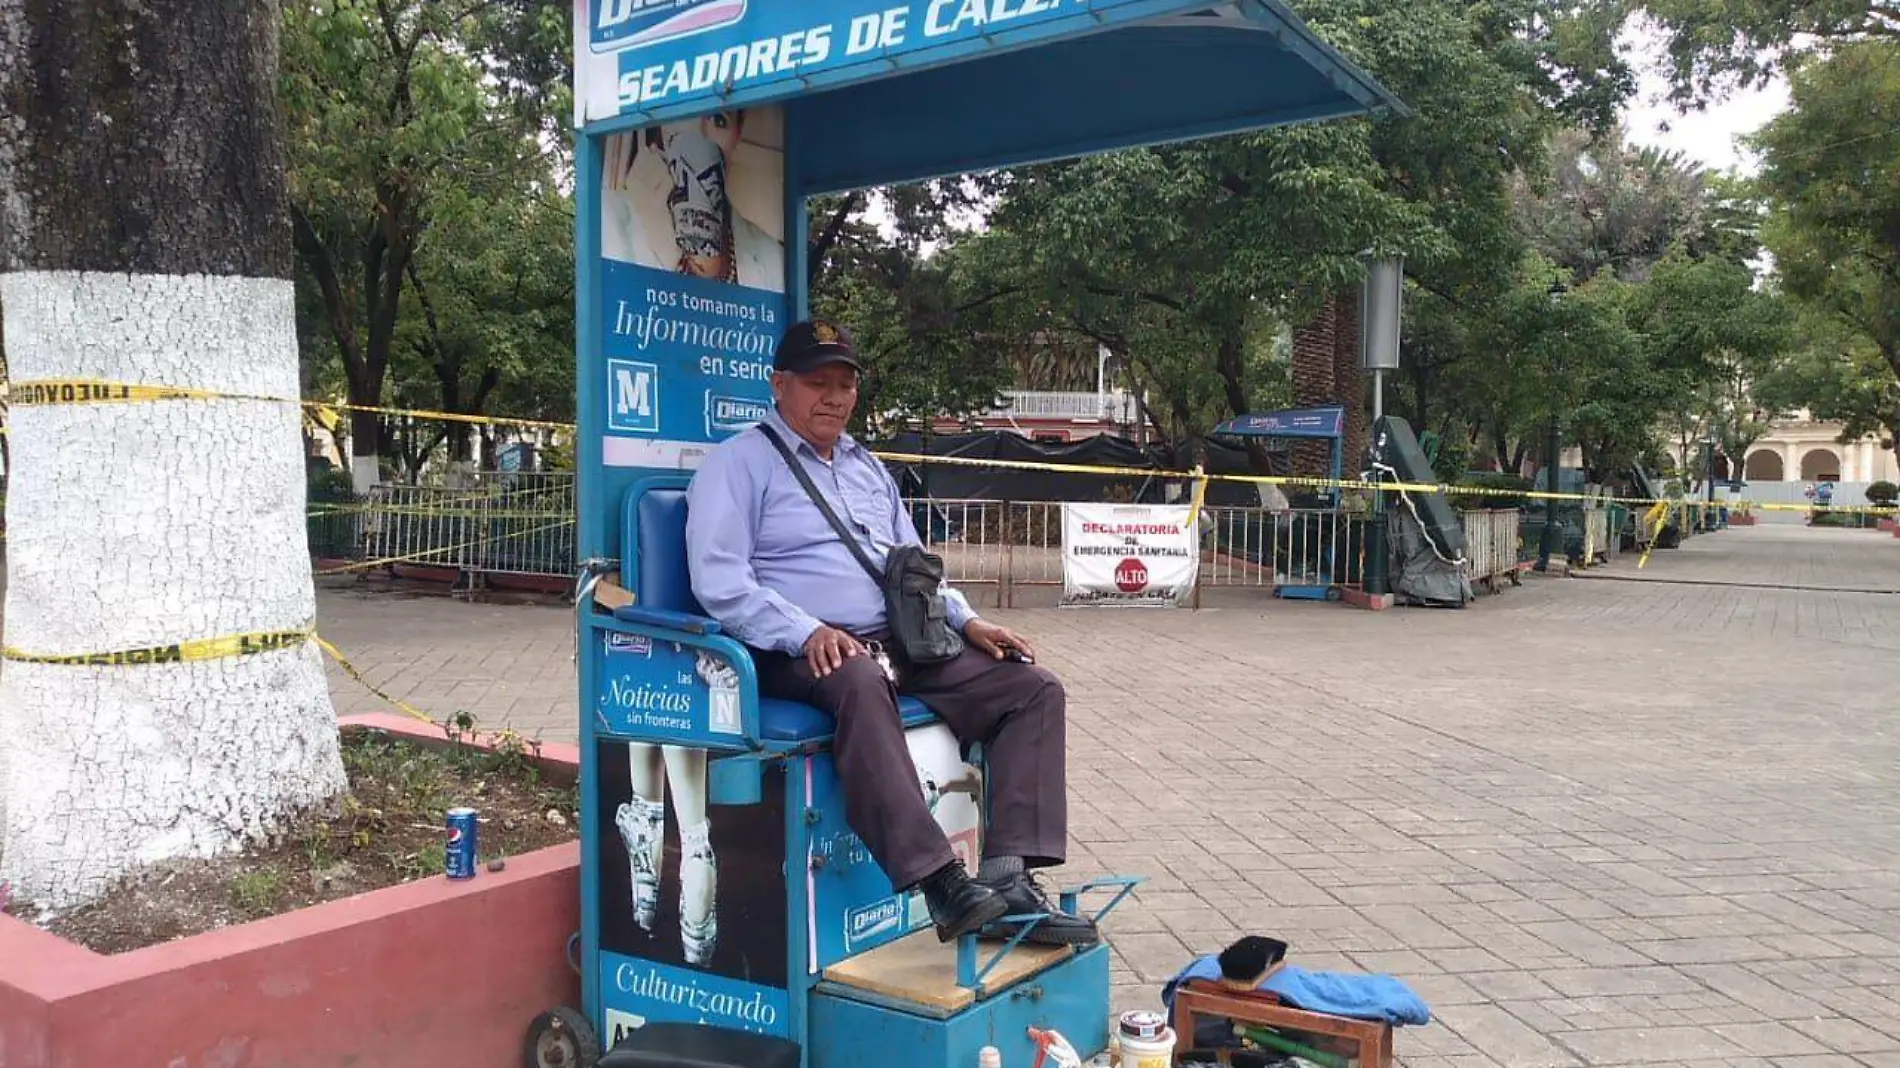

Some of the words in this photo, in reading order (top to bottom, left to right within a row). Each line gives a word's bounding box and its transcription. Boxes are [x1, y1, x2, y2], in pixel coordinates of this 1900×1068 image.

[619, 25, 832, 107] SEADORES
[845, 6, 909, 55] DE
[646, 288, 677, 307] nos
[682, 292, 756, 320] tomamos
[761, 304, 775, 323] la
[612, 300, 776, 357] Información
[700, 355, 724, 376] en
[729, 358, 774, 381] serio
[616, 369, 651, 416] M
[717, 401, 767, 420] Diario
[1082, 523, 1180, 535] DECLARATORIA
[1074, 546, 1136, 556] EMERGENCIA
[1115, 569, 1148, 584] ALTO
[677, 671, 693, 685] las
[601, 674, 691, 713] Noticias
[627, 711, 642, 725] sin
[644, 711, 691, 730] fronteras
[715, 693, 735, 725] N
[854, 902, 896, 929] Diario
[616, 963, 776, 1025] Culturizando
